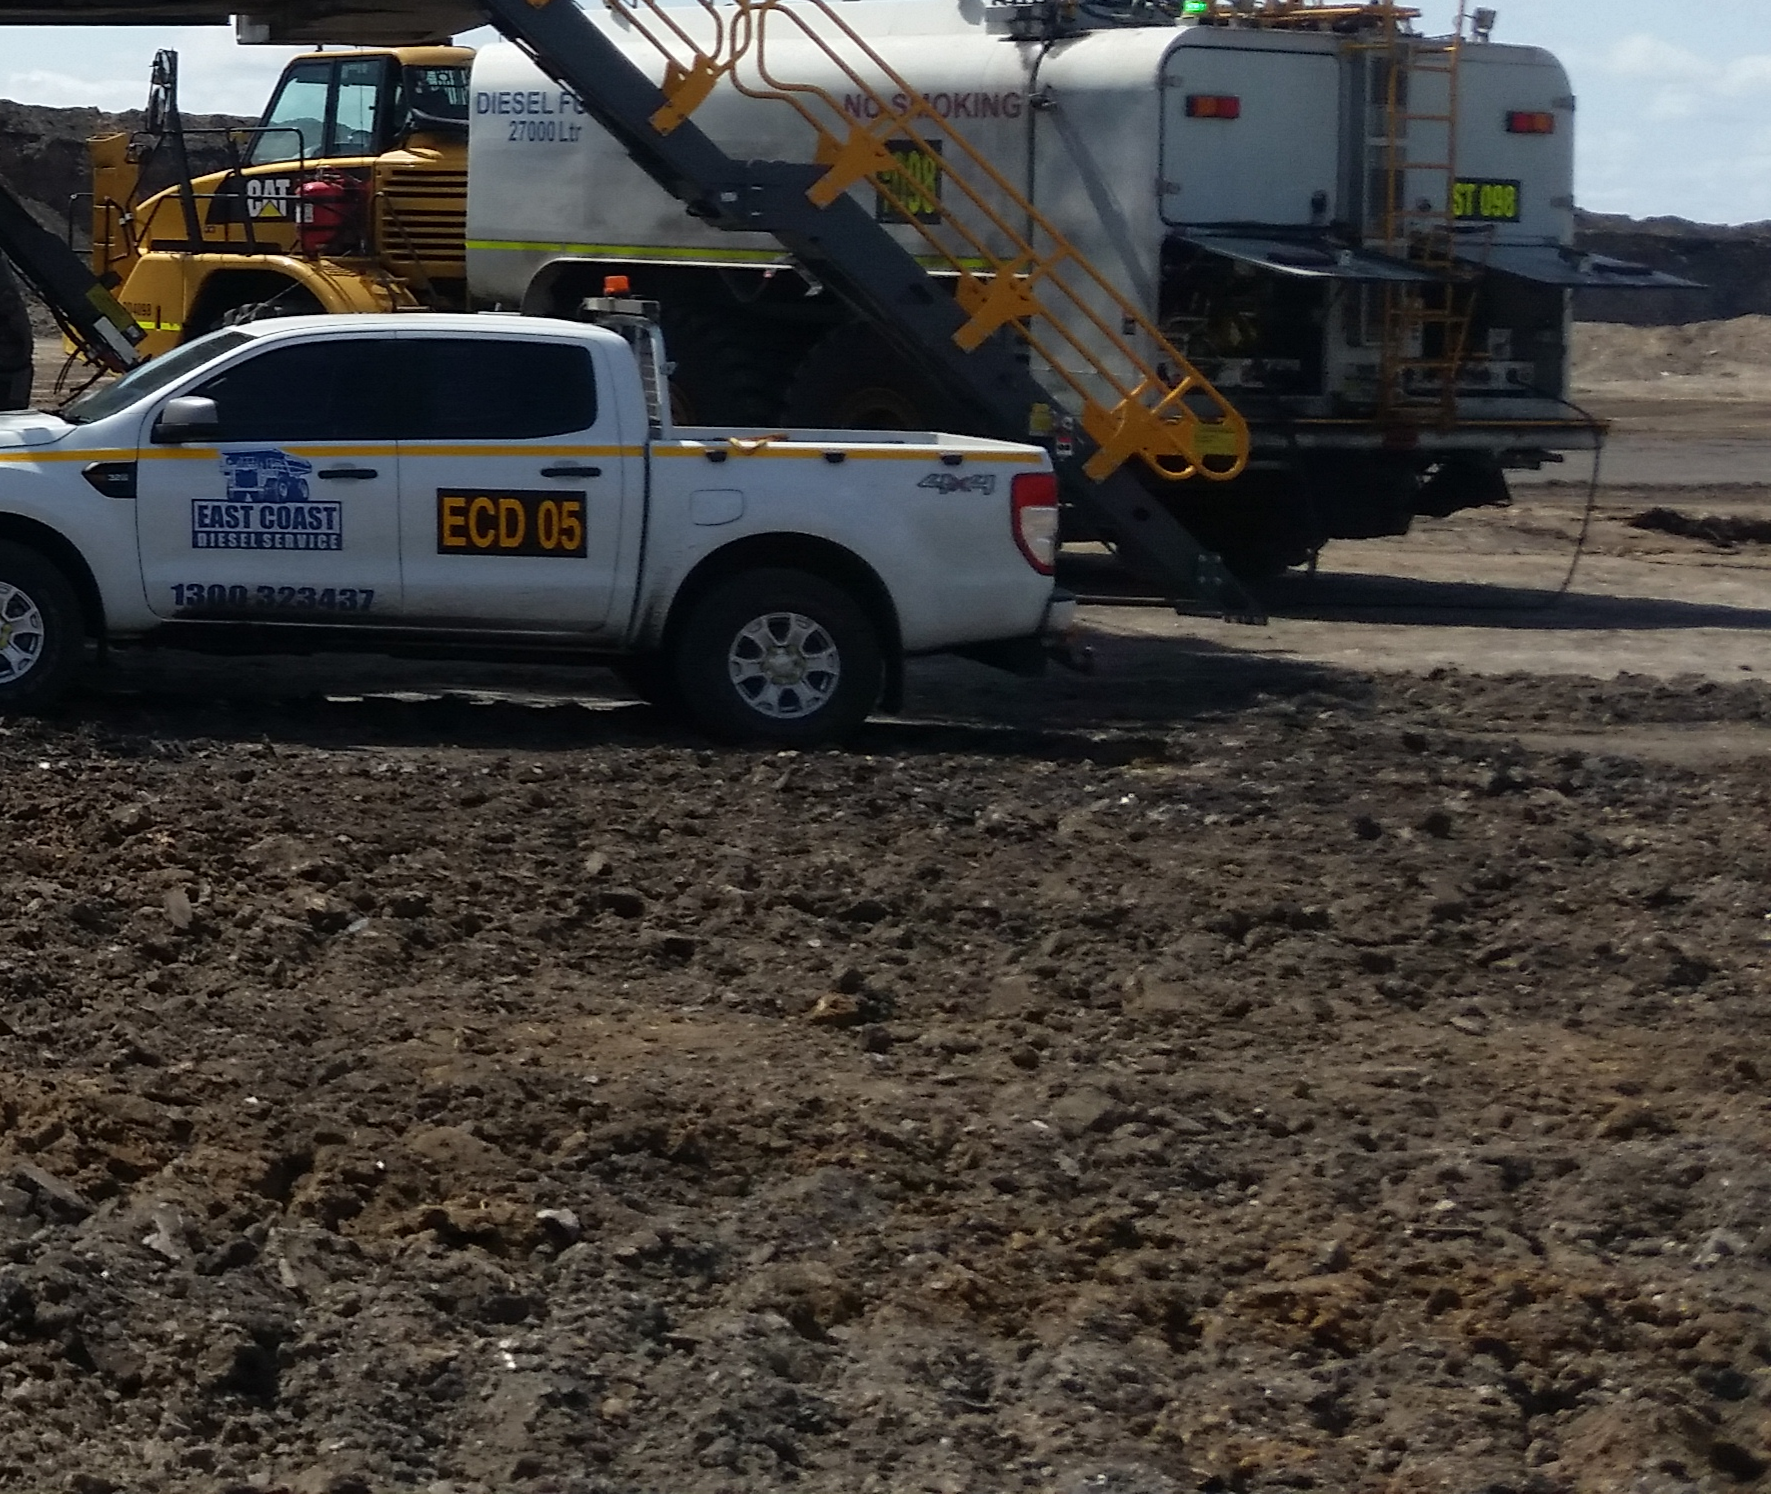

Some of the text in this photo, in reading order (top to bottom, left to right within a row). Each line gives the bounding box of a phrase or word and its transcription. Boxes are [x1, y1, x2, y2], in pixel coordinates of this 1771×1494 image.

[476, 91, 555, 115] DIESEL
[843, 92, 881, 119] NO
[507, 119, 583, 143] 27000 Ltr
[246, 178, 291, 218] CAT
[1480, 184, 1516, 219] 098
[196, 504, 338, 531] EAST COAST
[442, 494, 581, 552] ECD 05
[197, 532, 339, 550] DIESEL SERVICE
[170, 583, 375, 612] 1300 323437
